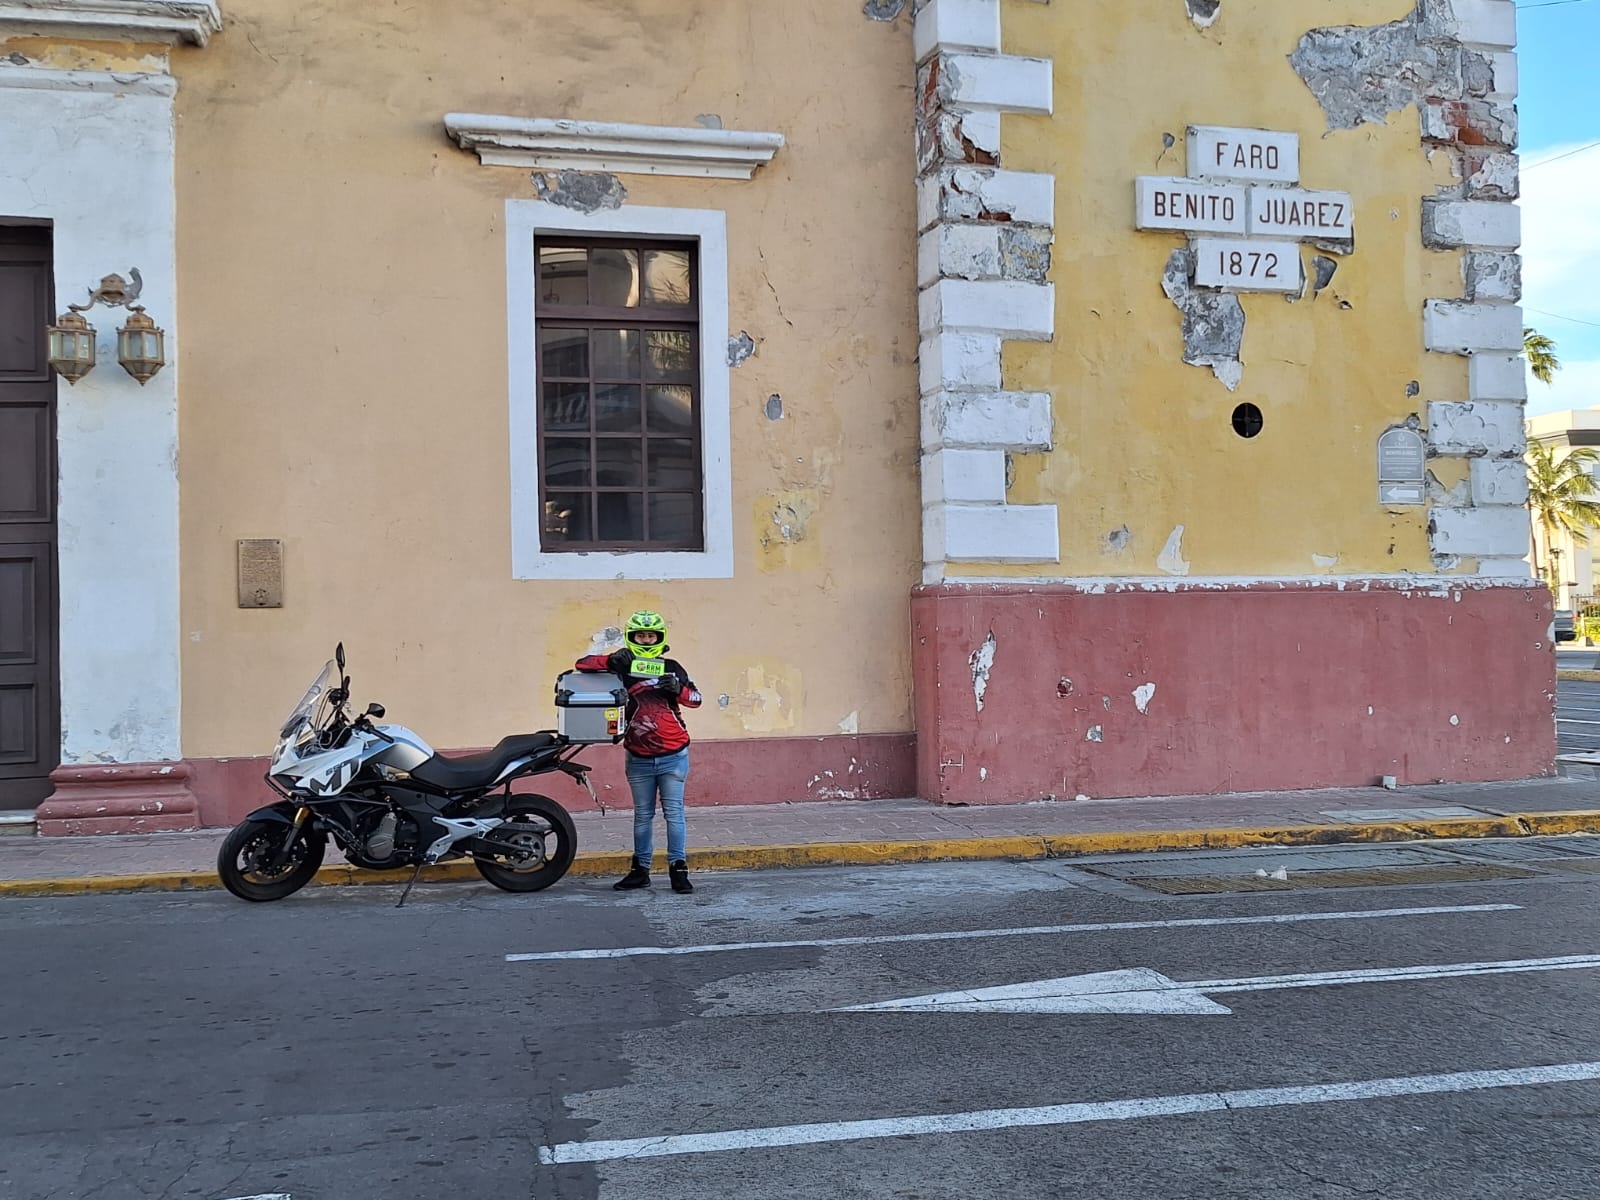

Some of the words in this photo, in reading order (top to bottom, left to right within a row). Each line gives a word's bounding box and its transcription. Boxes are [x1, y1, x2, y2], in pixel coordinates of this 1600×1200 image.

[1216, 142, 1279, 170] FARO
[1154, 191, 1234, 221] BENITO
[1259, 198, 1345, 228] JUAREZ
[1219, 251, 1278, 278] 1872
